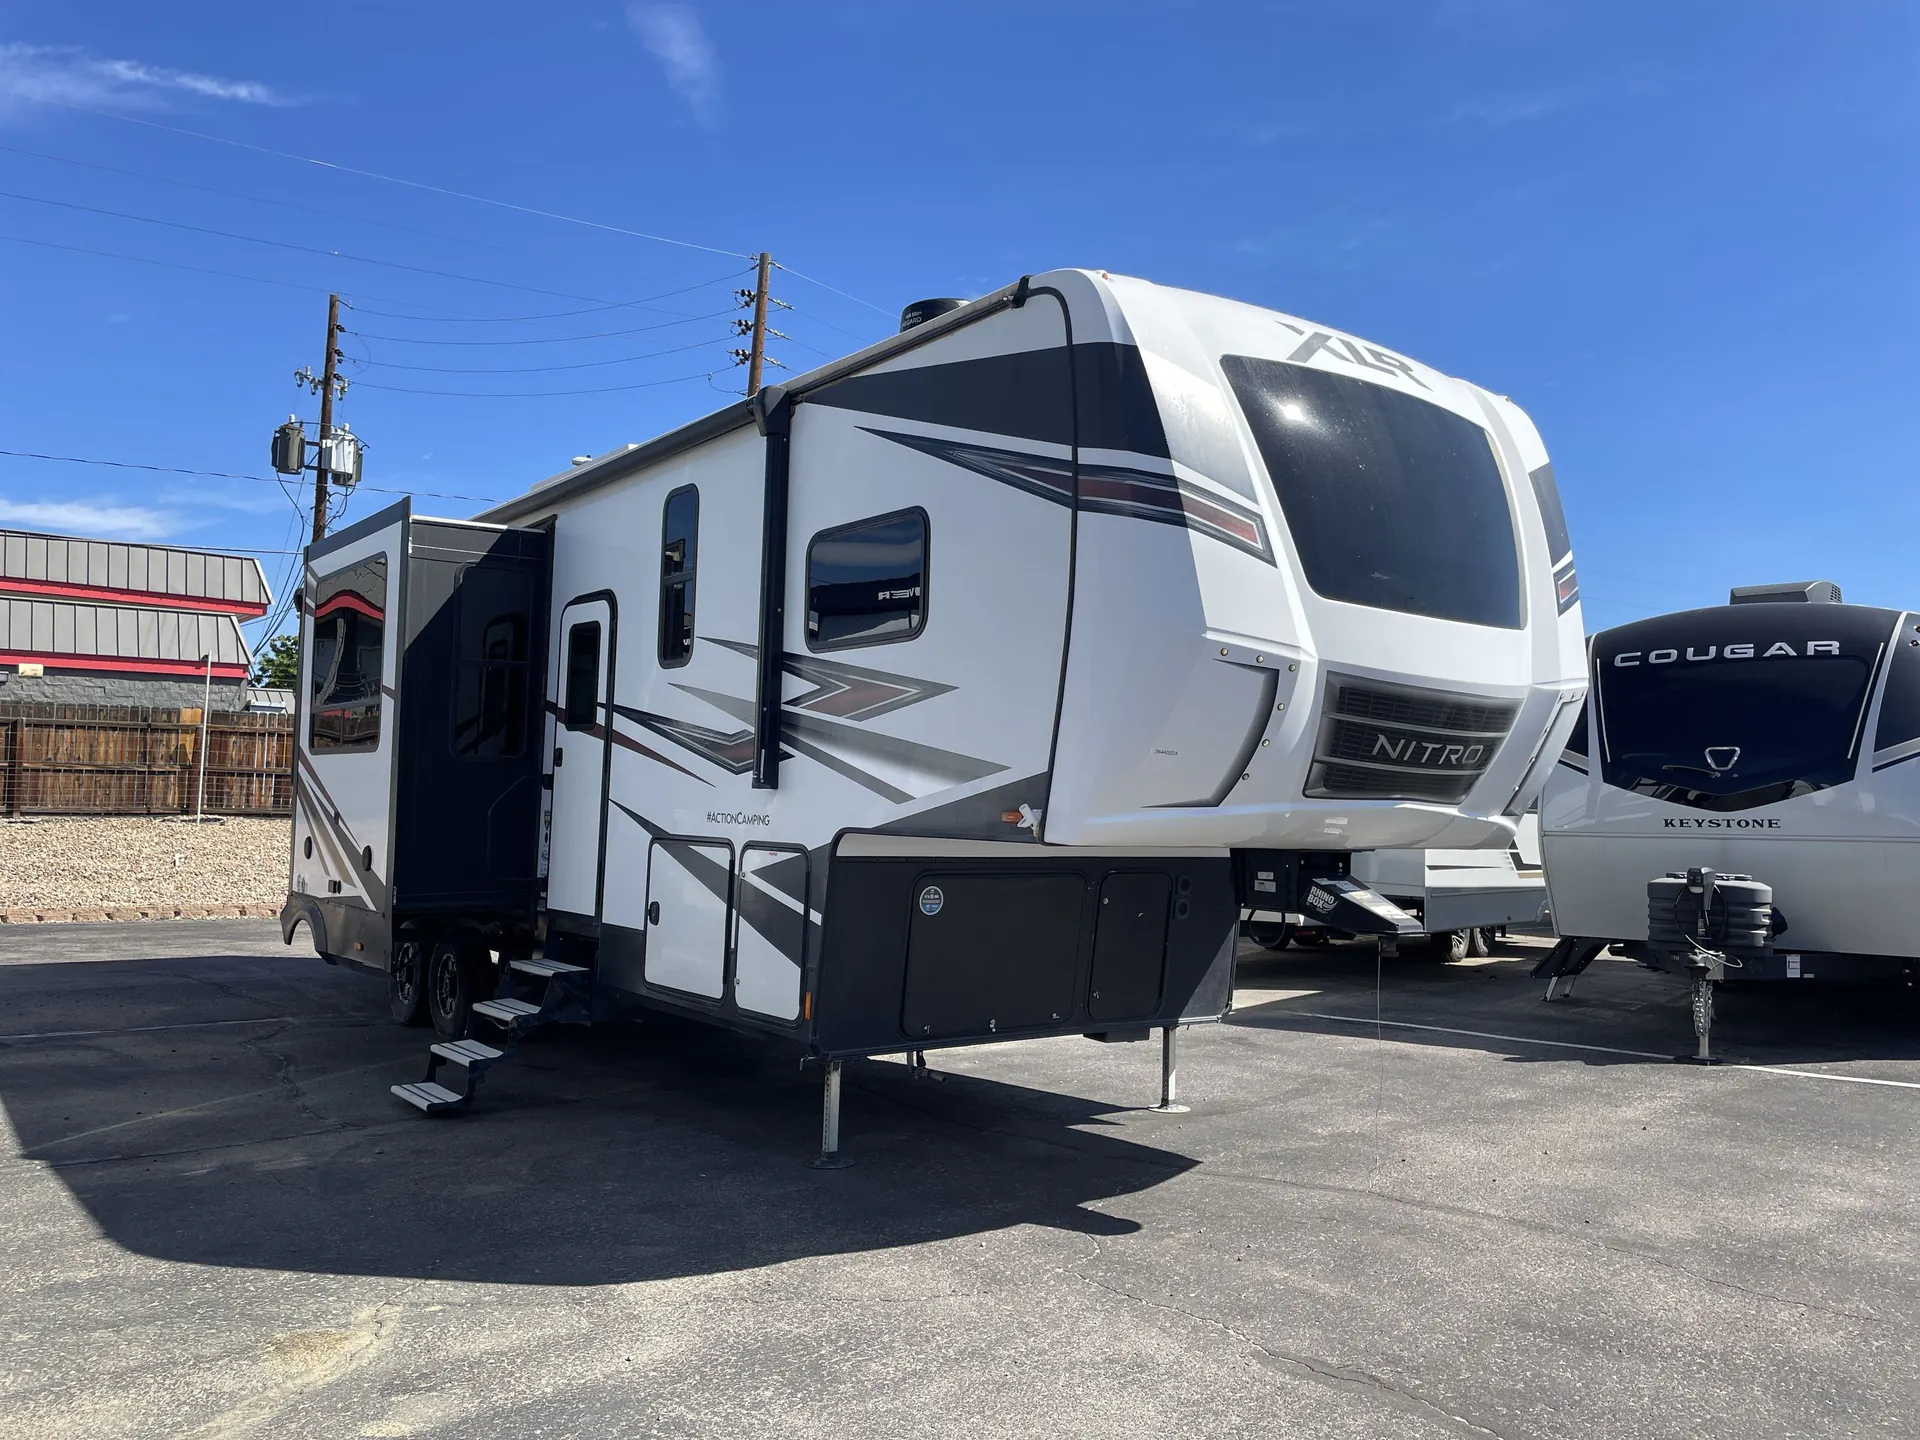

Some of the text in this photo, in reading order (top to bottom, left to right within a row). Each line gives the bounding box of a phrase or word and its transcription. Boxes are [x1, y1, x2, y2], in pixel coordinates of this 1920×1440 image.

[1274, 321, 1434, 392] XLR
[1614, 640, 1840, 667] COUGAR
[1371, 733, 1484, 765] NITRO
[1663, 818, 1781, 829] KEYSTONE
[1307, 893, 1325, 908] BOX
[1310, 886, 1334, 904] RHINO
